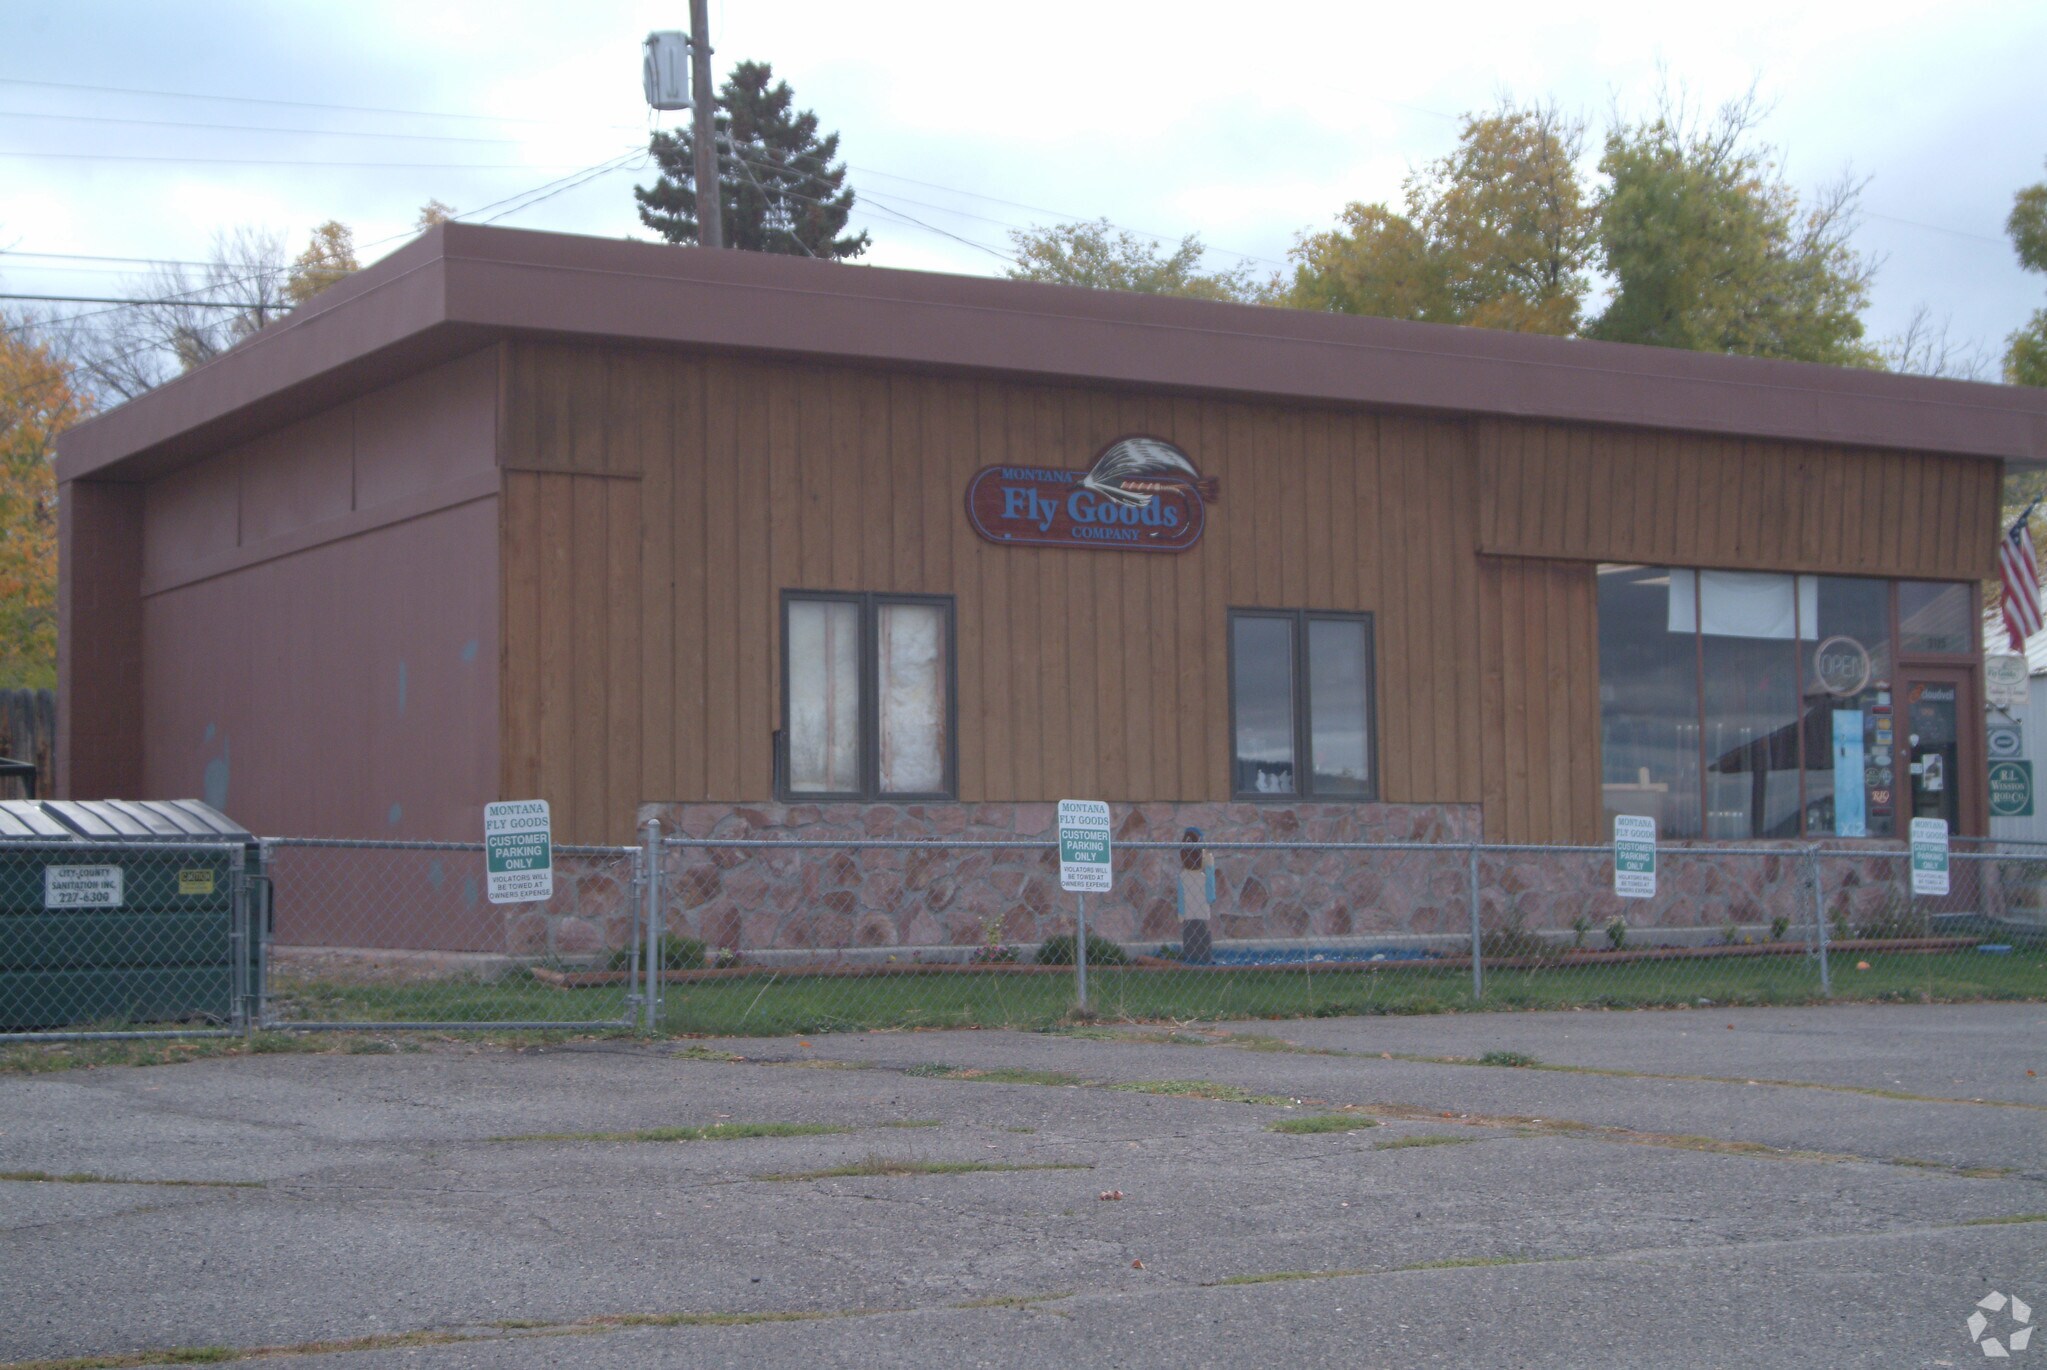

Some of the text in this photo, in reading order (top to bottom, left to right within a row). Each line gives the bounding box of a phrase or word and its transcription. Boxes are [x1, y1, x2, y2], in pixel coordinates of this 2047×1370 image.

[1002, 467, 1073, 483] MONTANA
[1001, 487, 1178, 532] Fly Goods
[1071, 527, 1140, 541] COMPANY
[1822, 653, 1865, 678] OPEN
[490, 804, 544, 816] MONTANA
[1062, 803, 1105, 813] MONTANA
[486, 816, 549, 831] FLY GOODS
[1059, 814, 1109, 826] FLY GOODS
[1618, 817, 1652, 828] MONTANA
[1062, 830, 1108, 840] CUSTOMER
[1616, 828, 1655, 839] FLY GOODS
[489, 834, 548, 847] CUSTOMER
[1067, 840, 1104, 851] PARKING
[495, 846, 542, 858] PARKING
[1618, 842, 1654, 852] CUSTOMER
[1074, 852, 1097, 861] ONLY
[1620, 851, 1650, 862] PARKING
[506, 858, 533, 869] ONLY
[1626, 861, 1645, 870] ONLY
[59, 869, 110, 877] CITY-COUNTY
[492, 875, 530, 883] VIOLATORS
[52, 881, 98, 890] SANITATION
[489, 889, 551, 899] OWNERS EXPENSE
